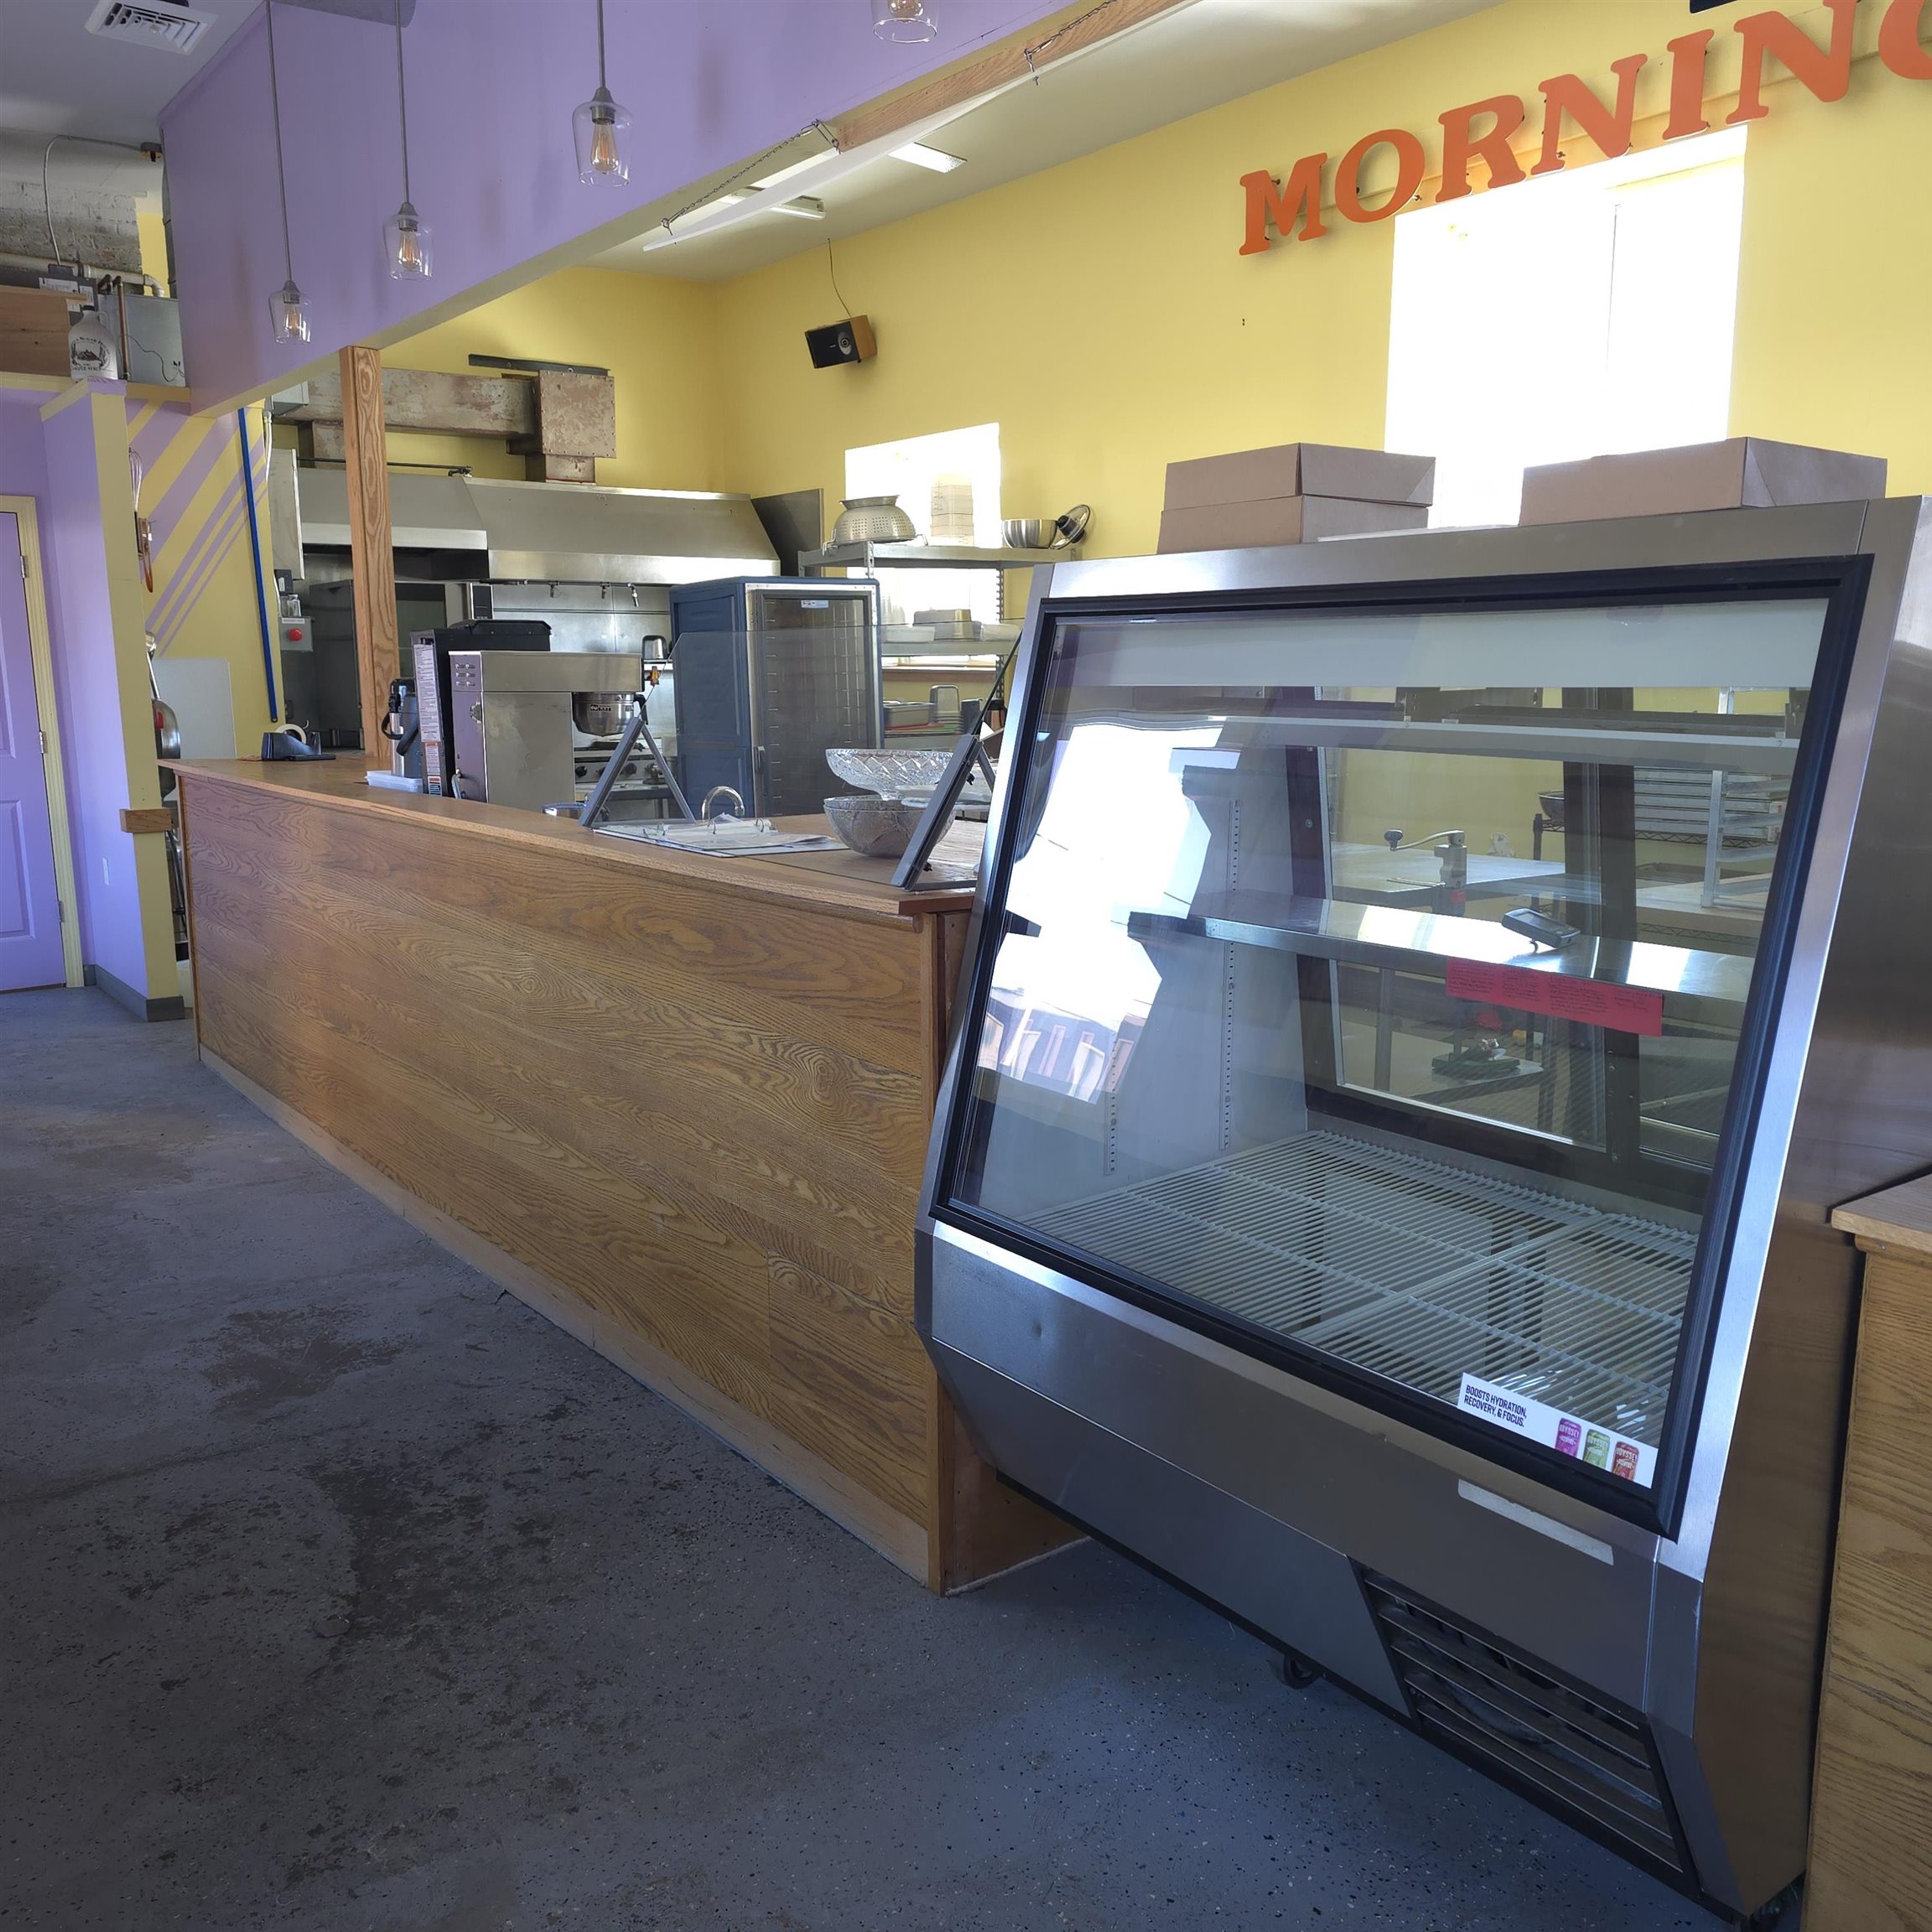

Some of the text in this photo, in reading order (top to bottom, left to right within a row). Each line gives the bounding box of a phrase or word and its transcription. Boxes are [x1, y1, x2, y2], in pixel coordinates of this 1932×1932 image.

[1464, 1394, 1524, 1427] RECOVERY, & FOCUS.
[1466, 1384, 1527, 1419] BOOSTS HYDRATION,
